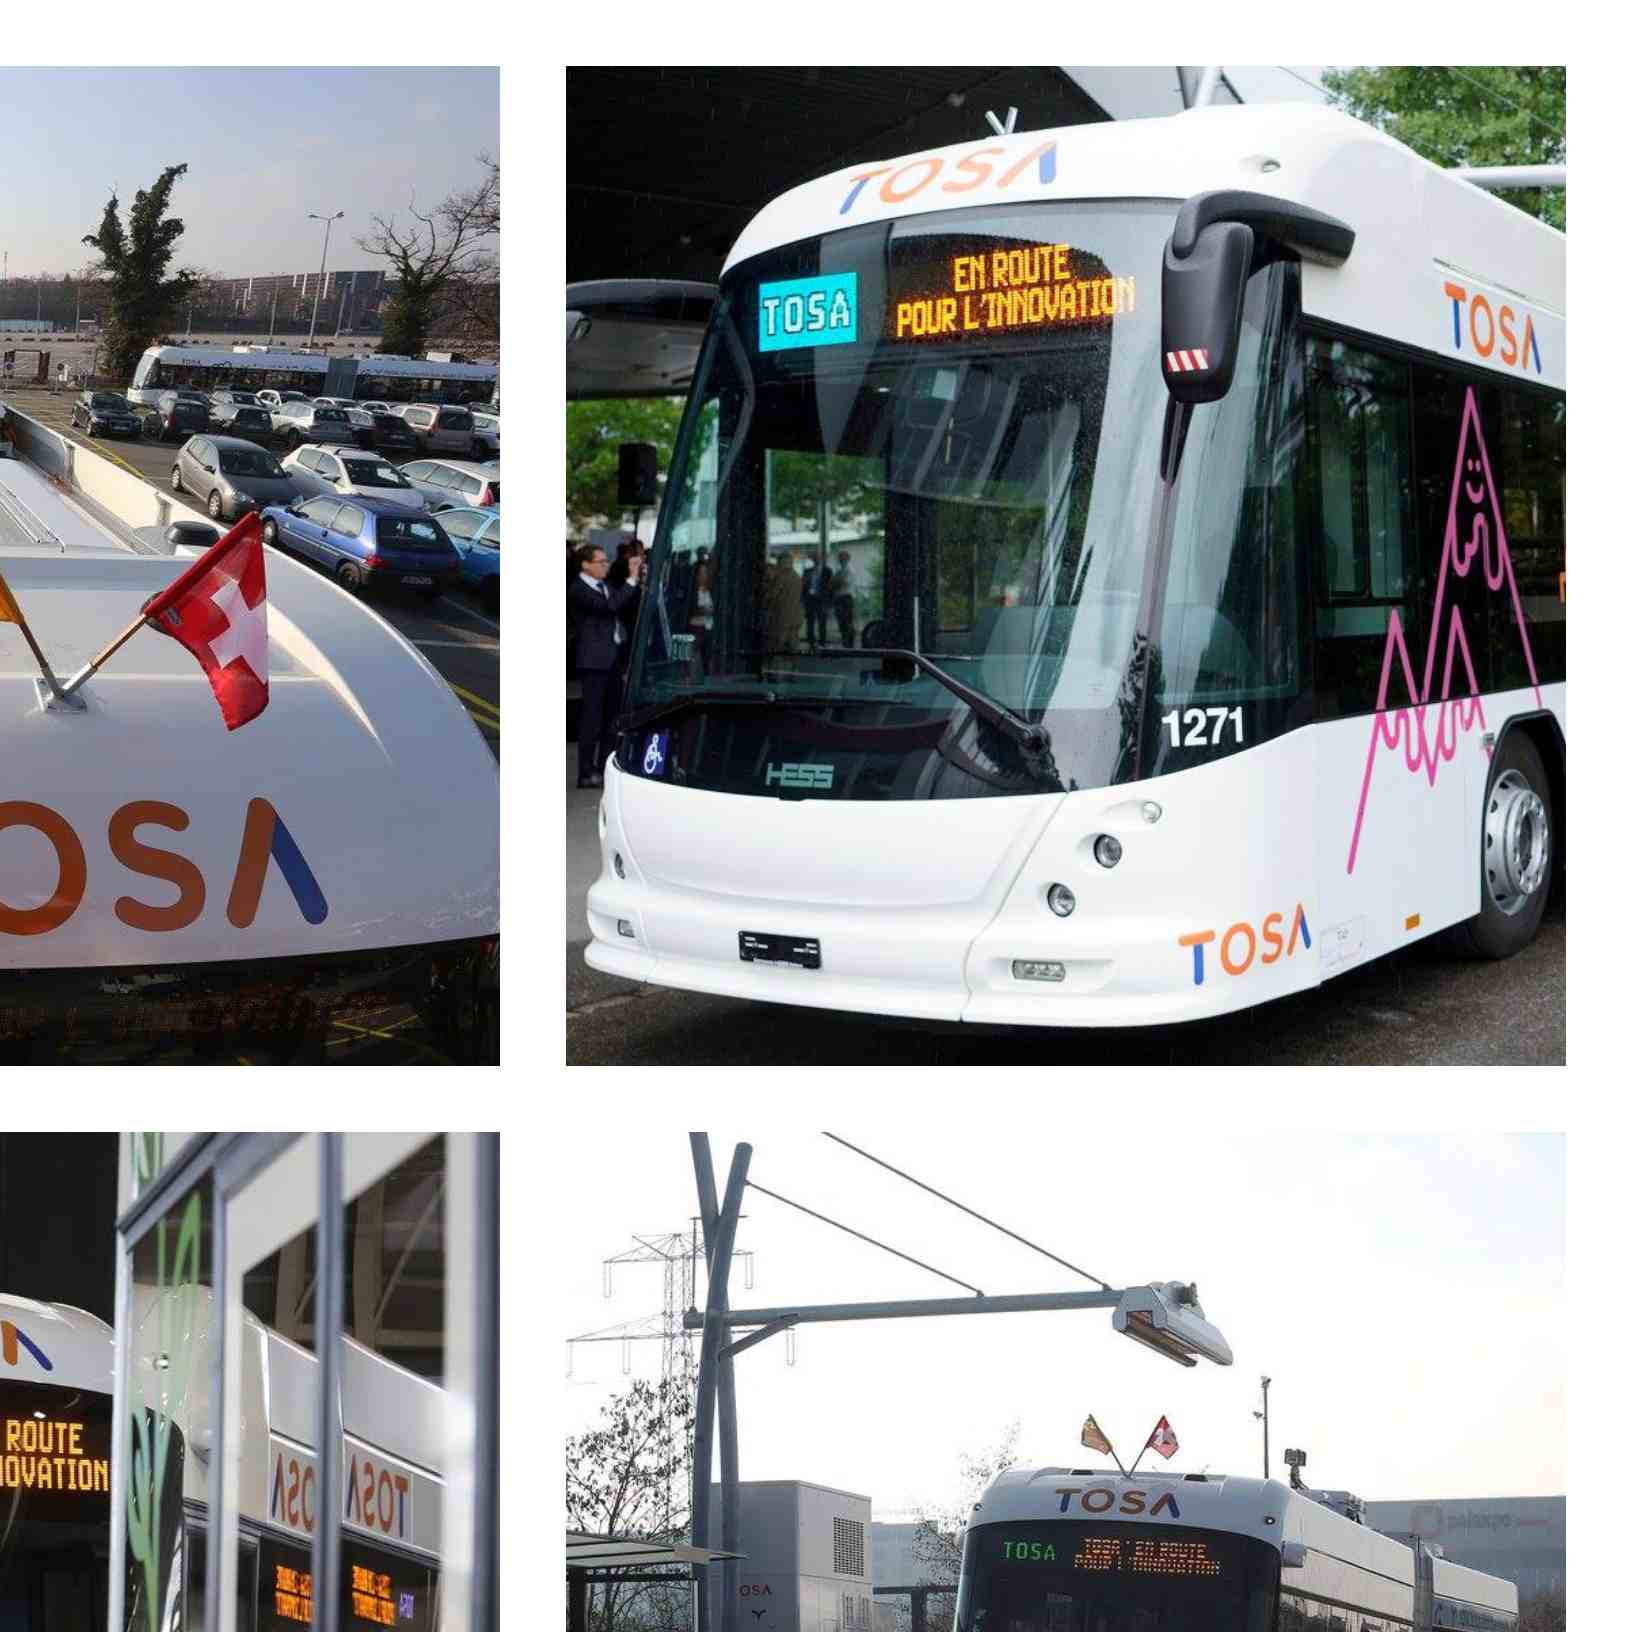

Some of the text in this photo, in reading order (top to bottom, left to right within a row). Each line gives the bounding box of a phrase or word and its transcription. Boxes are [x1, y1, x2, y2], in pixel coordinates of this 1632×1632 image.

[840, 140, 1057, 215] TOSA
[953, 243, 1071, 292] EN ROUTE
[763, 289, 850, 337] TOSA
[896, 275, 1136, 337] POUR L'INNOVATION
[1444, 281, 1542, 374] TOSA
[1161, 706, 1244, 747] 1271
[766, 762, 834, 789] HESS
[1178, 903, 1312, 986] TOSA
[7, 1420, 84, 1455] ROUTE
[1055, 1488, 1180, 1518] TOSA
[1004, 1541, 1056, 1560] TOSA
